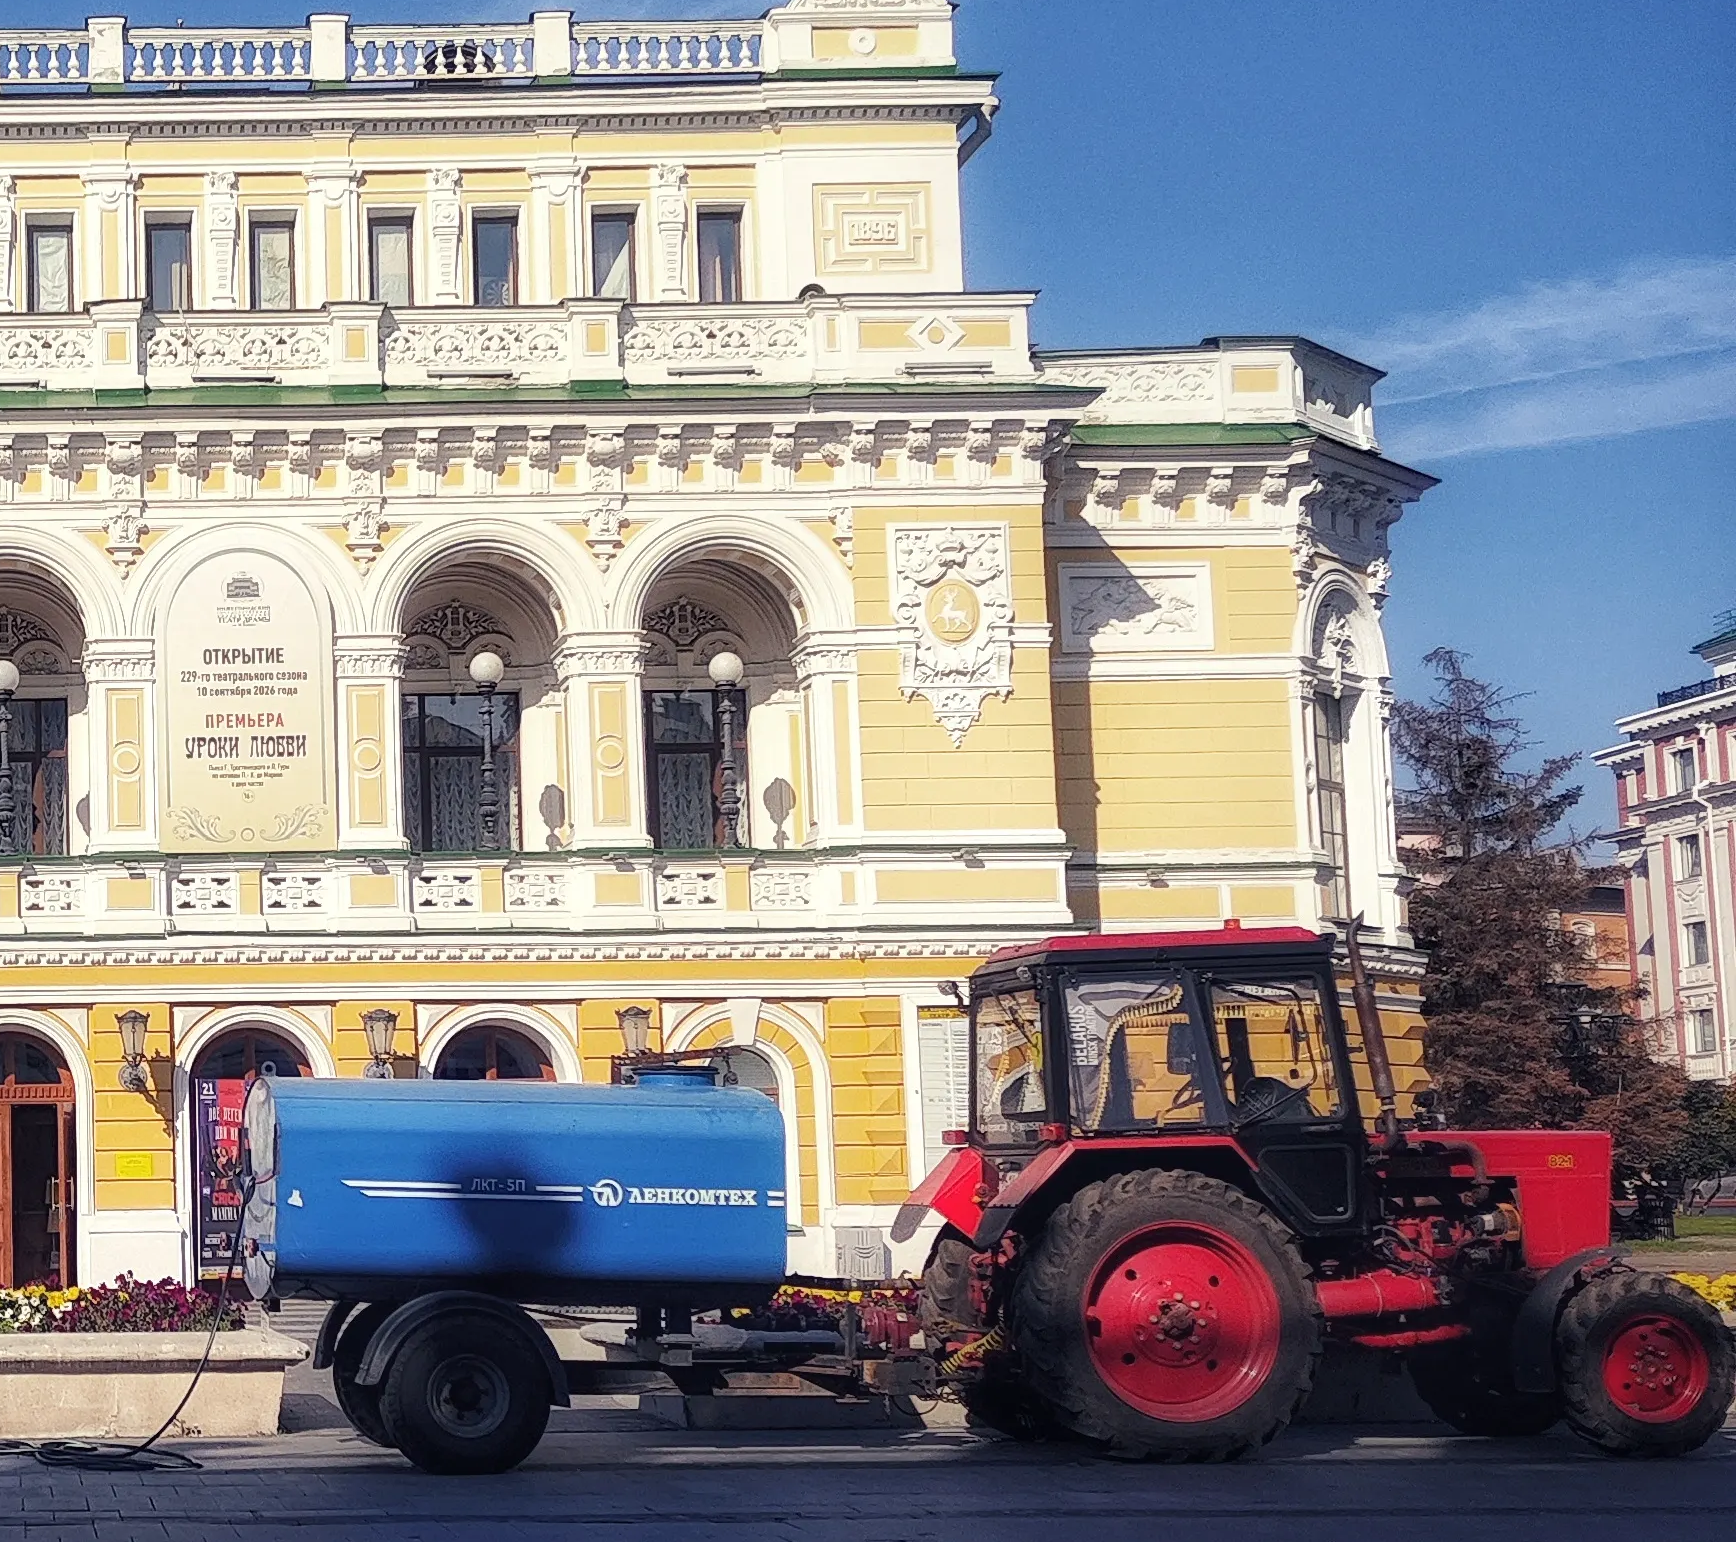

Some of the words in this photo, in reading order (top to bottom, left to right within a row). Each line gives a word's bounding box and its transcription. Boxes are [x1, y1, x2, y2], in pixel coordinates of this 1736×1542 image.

[850, 221, 897, 241] 1896
[203, 647, 284, 665] ОТКРЫТИЕ
[180, 671, 210, 682] 229-го
[213, 672, 273, 684] театрального
[276, 671, 307, 681] сезона
[197, 687, 207, 696] 10
[210, 686, 251, 698] сентября
[277, 687, 298, 696] года
[205, 713, 284, 728] ПРЕМЬЕРА
[185, 737, 239, 759] УРОКИ
[250, 735, 306, 757] ЛЮБВИ
[202, 1082, 215, 1095] 21
[471, 1178, 525, 1191] ЛКТ-5П
[212, 1191, 242, 1206] CHICA
[626, 1187, 758, 1206] ЛЕНКОМТЕХ
